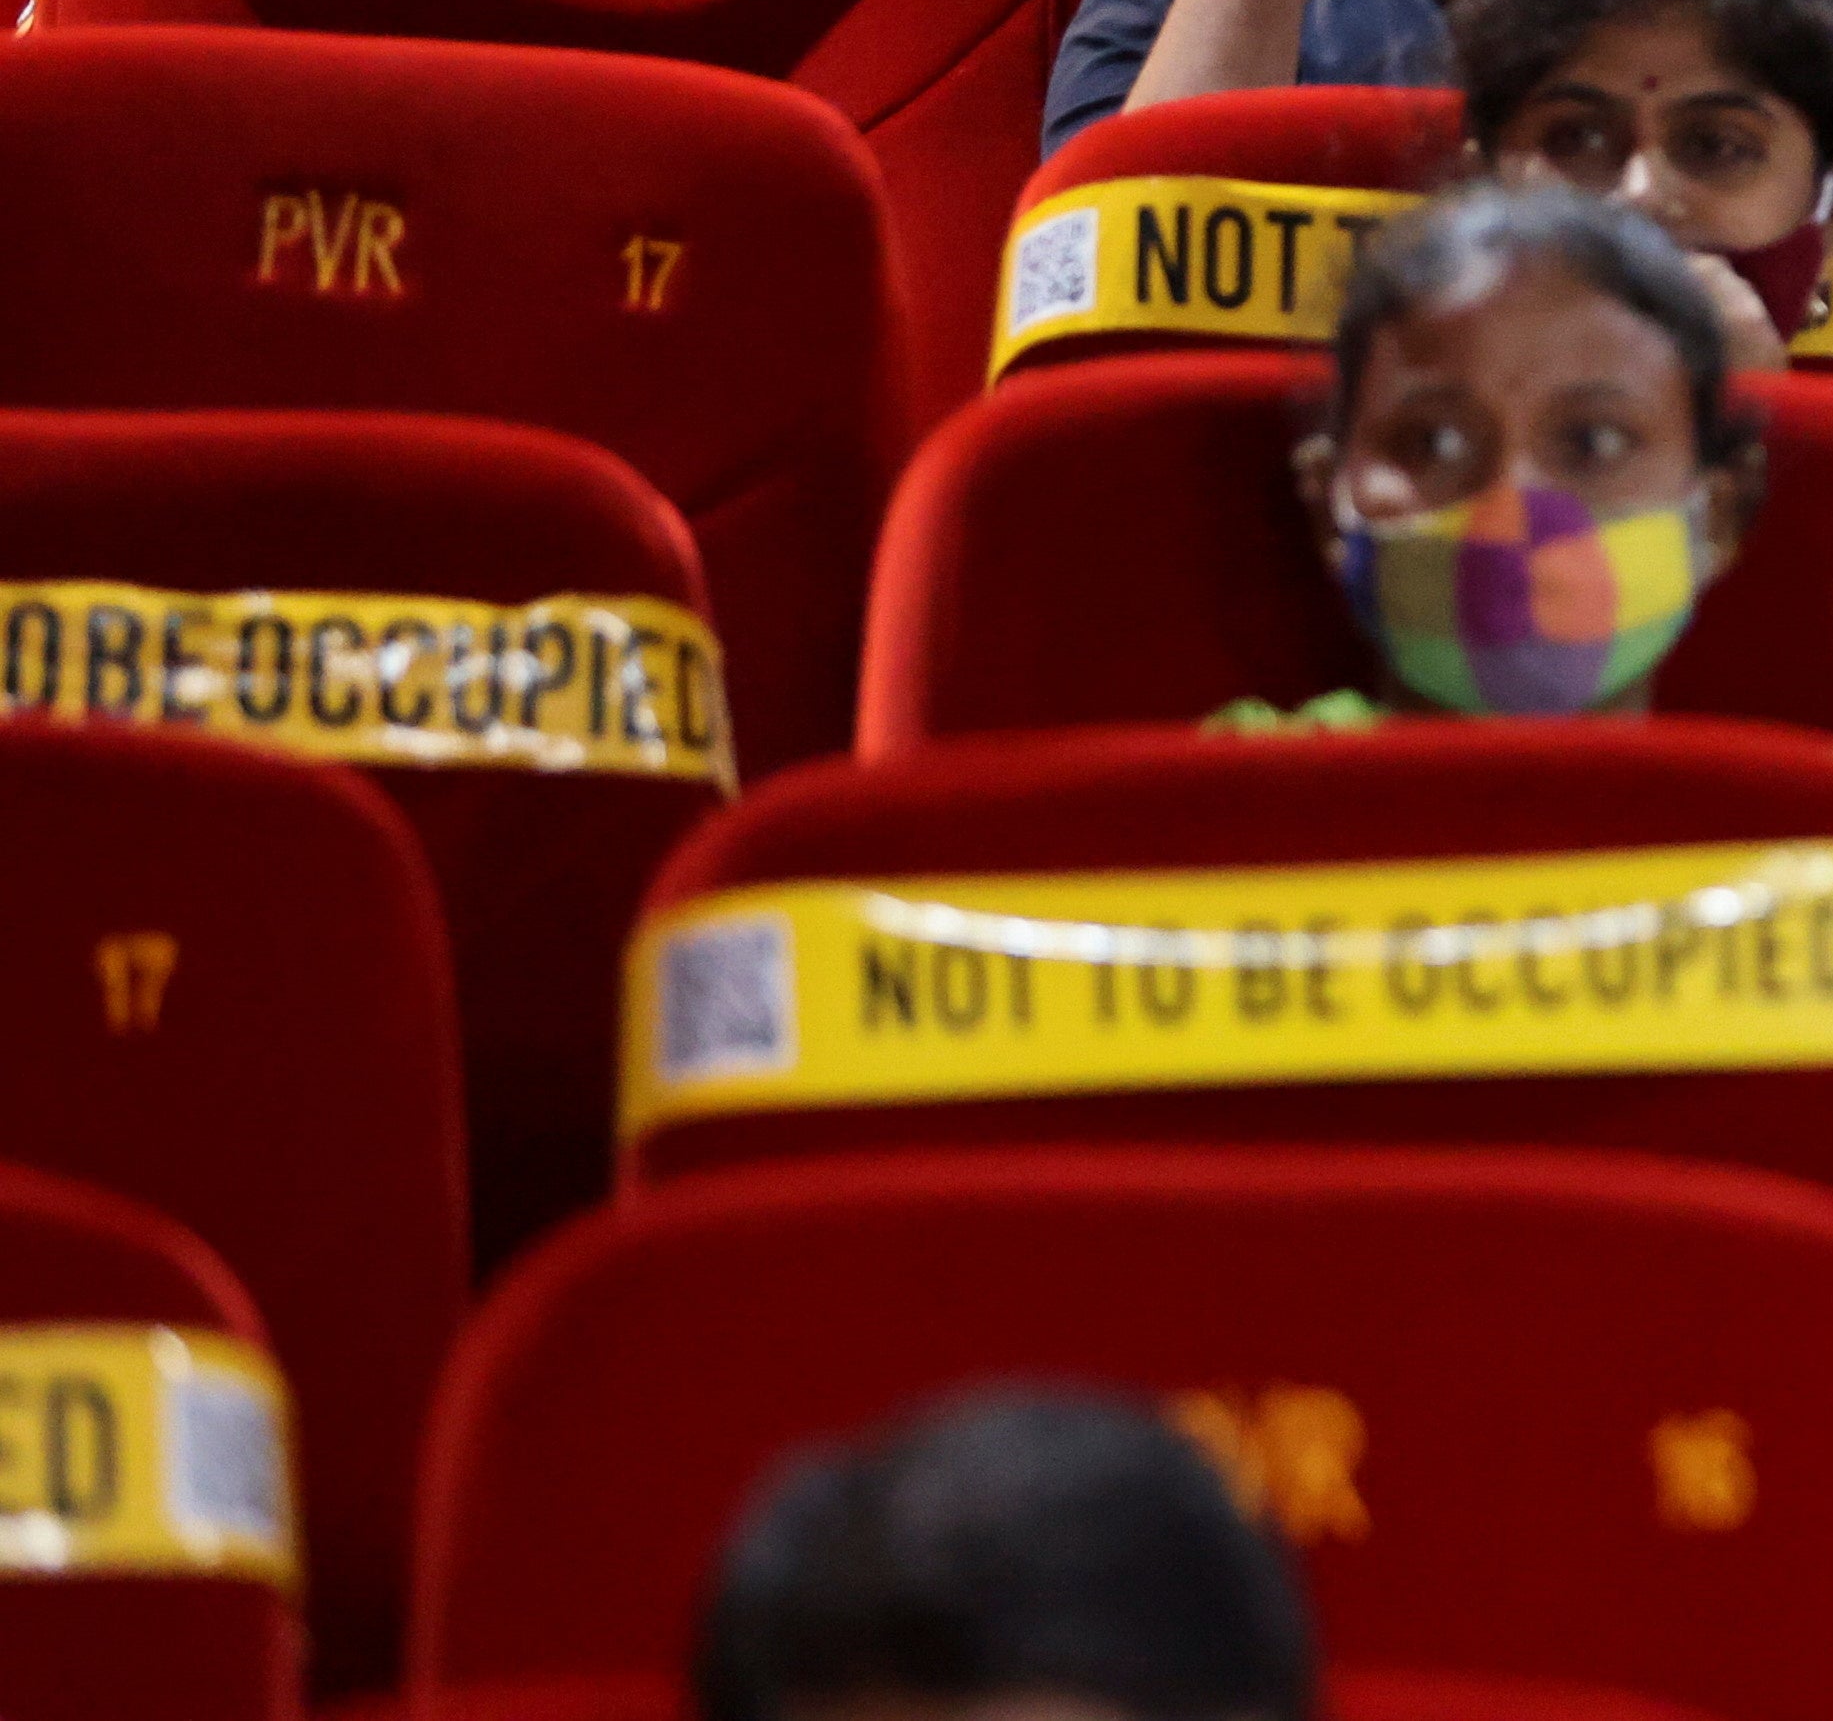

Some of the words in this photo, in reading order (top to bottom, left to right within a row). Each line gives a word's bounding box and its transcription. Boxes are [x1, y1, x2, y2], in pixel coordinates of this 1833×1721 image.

[260, 192, 405, 294] PVR
[623, 238, 681, 311] 17
[1137, 206, 1312, 311] NOT
[236, 616, 716, 751] OCCUPIED
